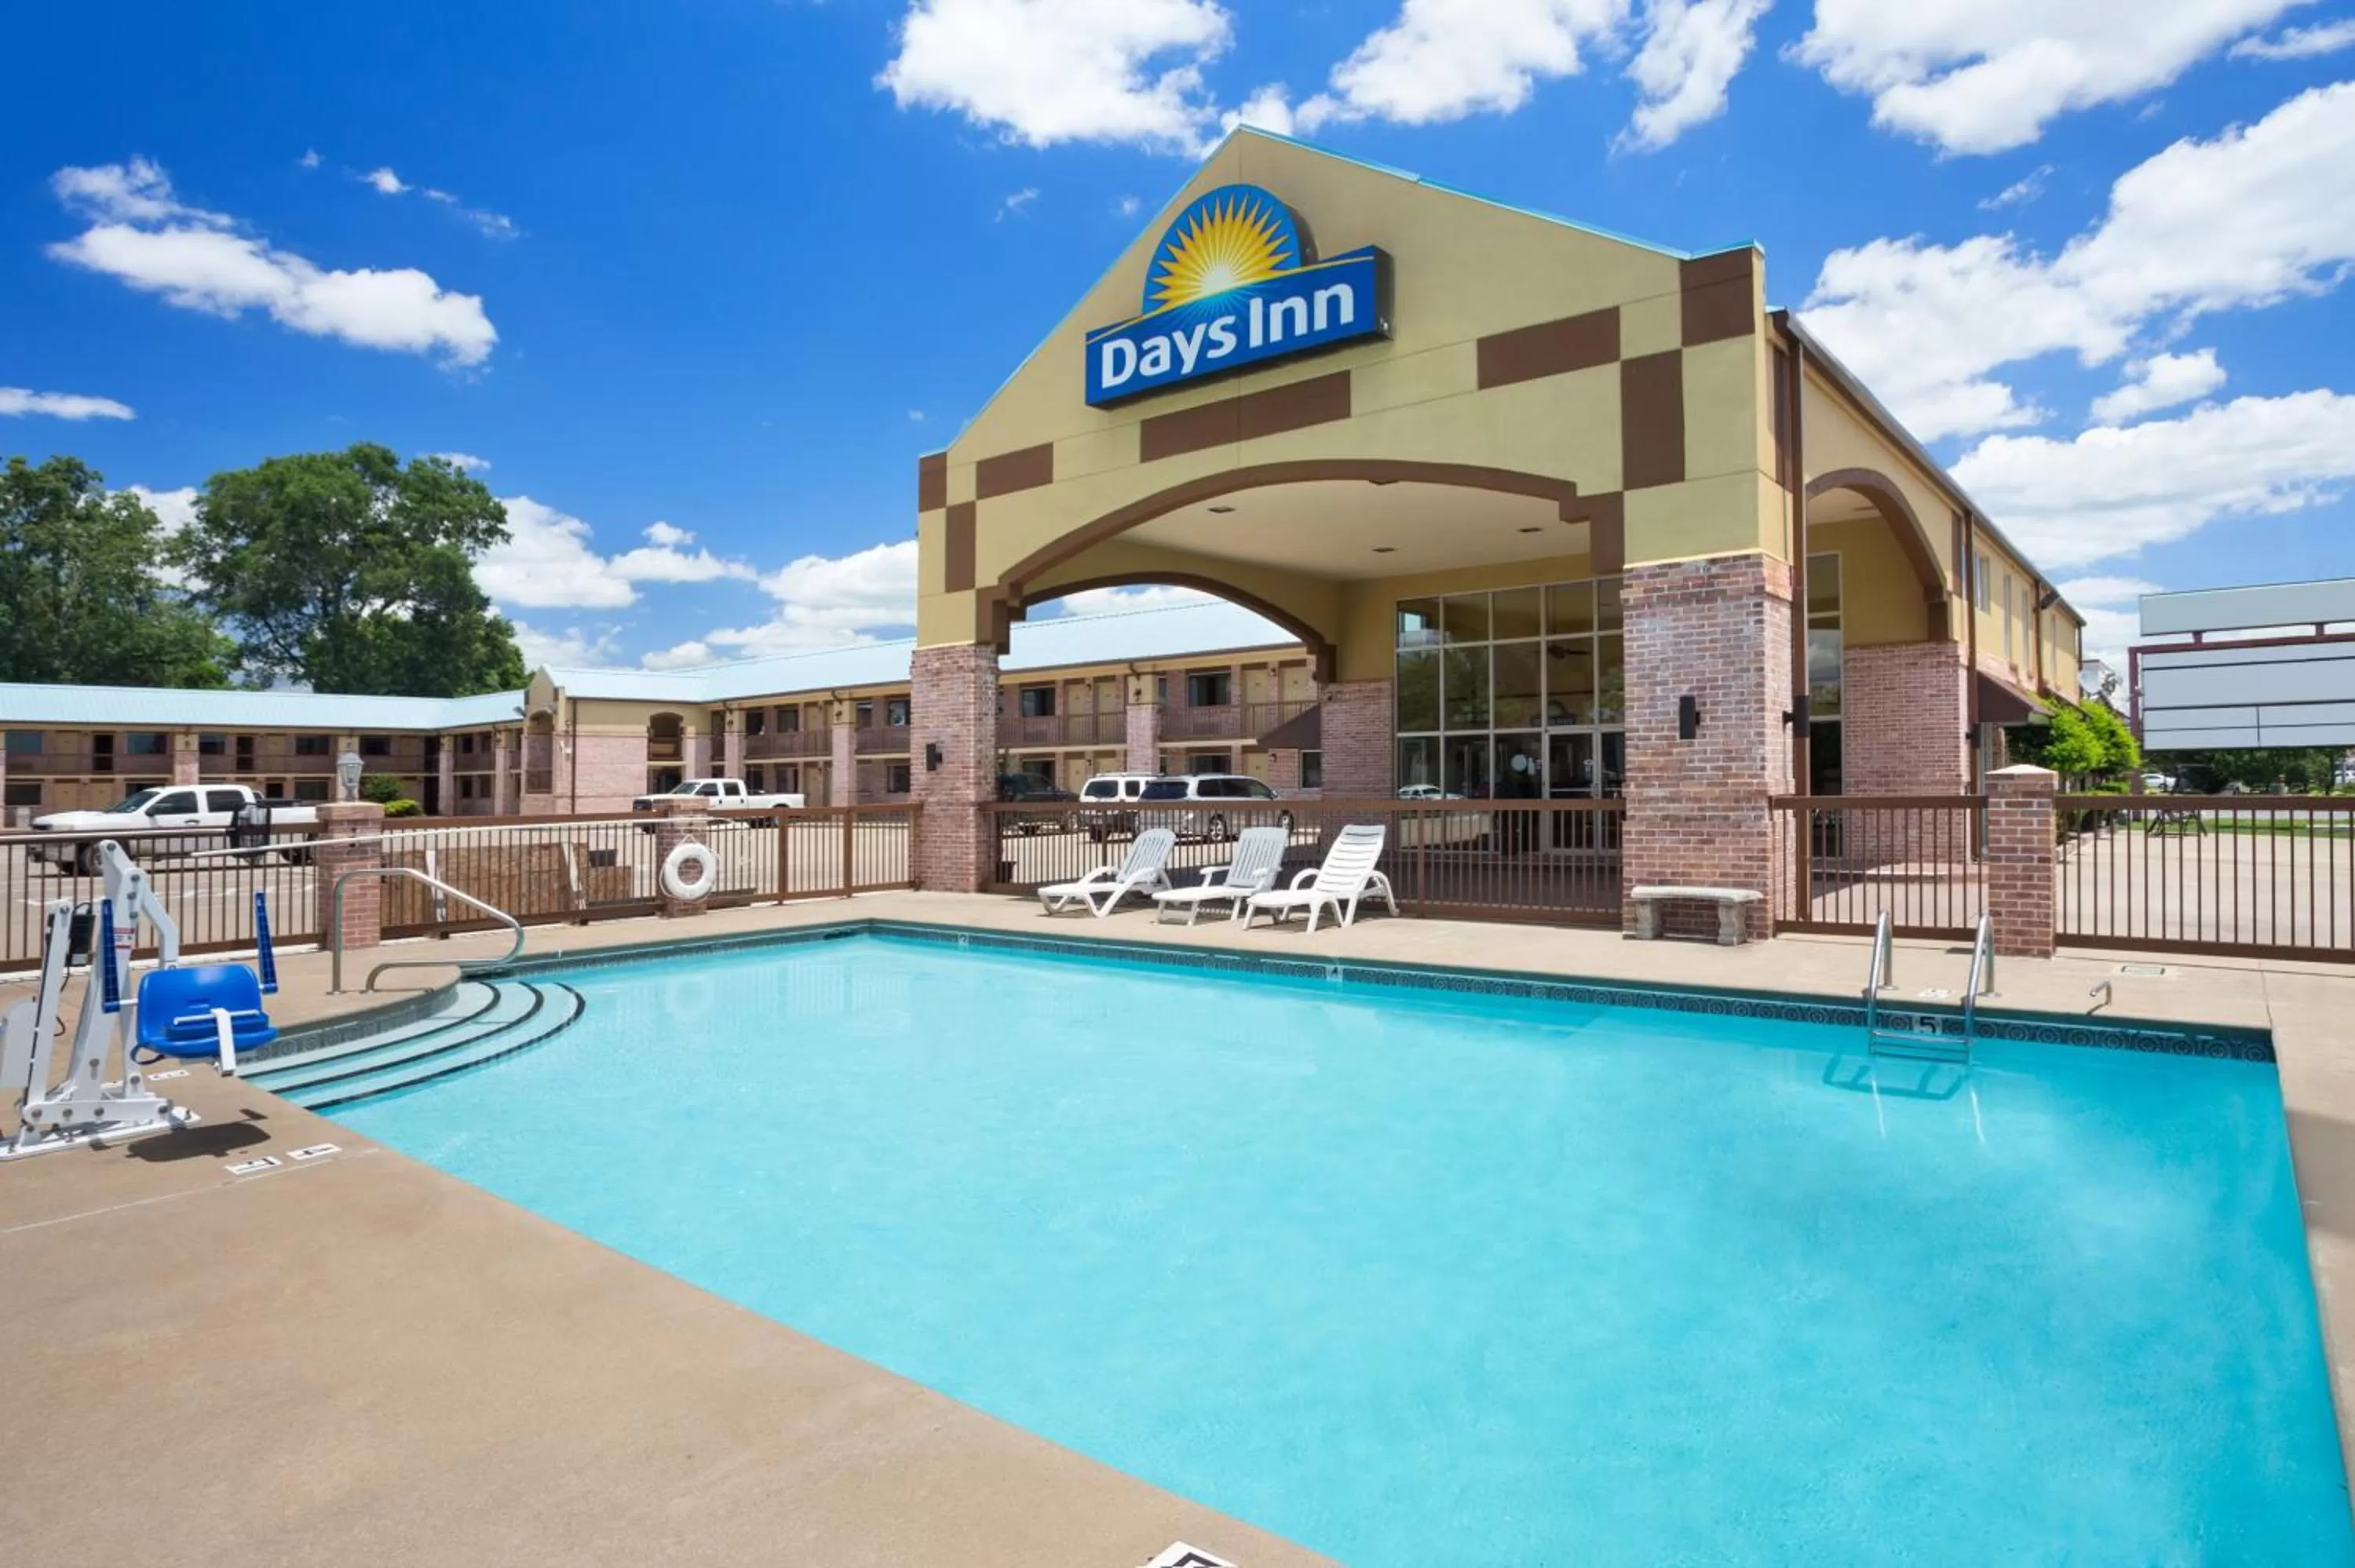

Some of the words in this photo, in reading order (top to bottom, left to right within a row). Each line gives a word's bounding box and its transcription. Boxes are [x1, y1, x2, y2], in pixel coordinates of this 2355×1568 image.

[1101, 315, 1237, 389] Days
[1249, 283, 1354, 348] Inn
[1919, 1016, 1937, 1034] 5
